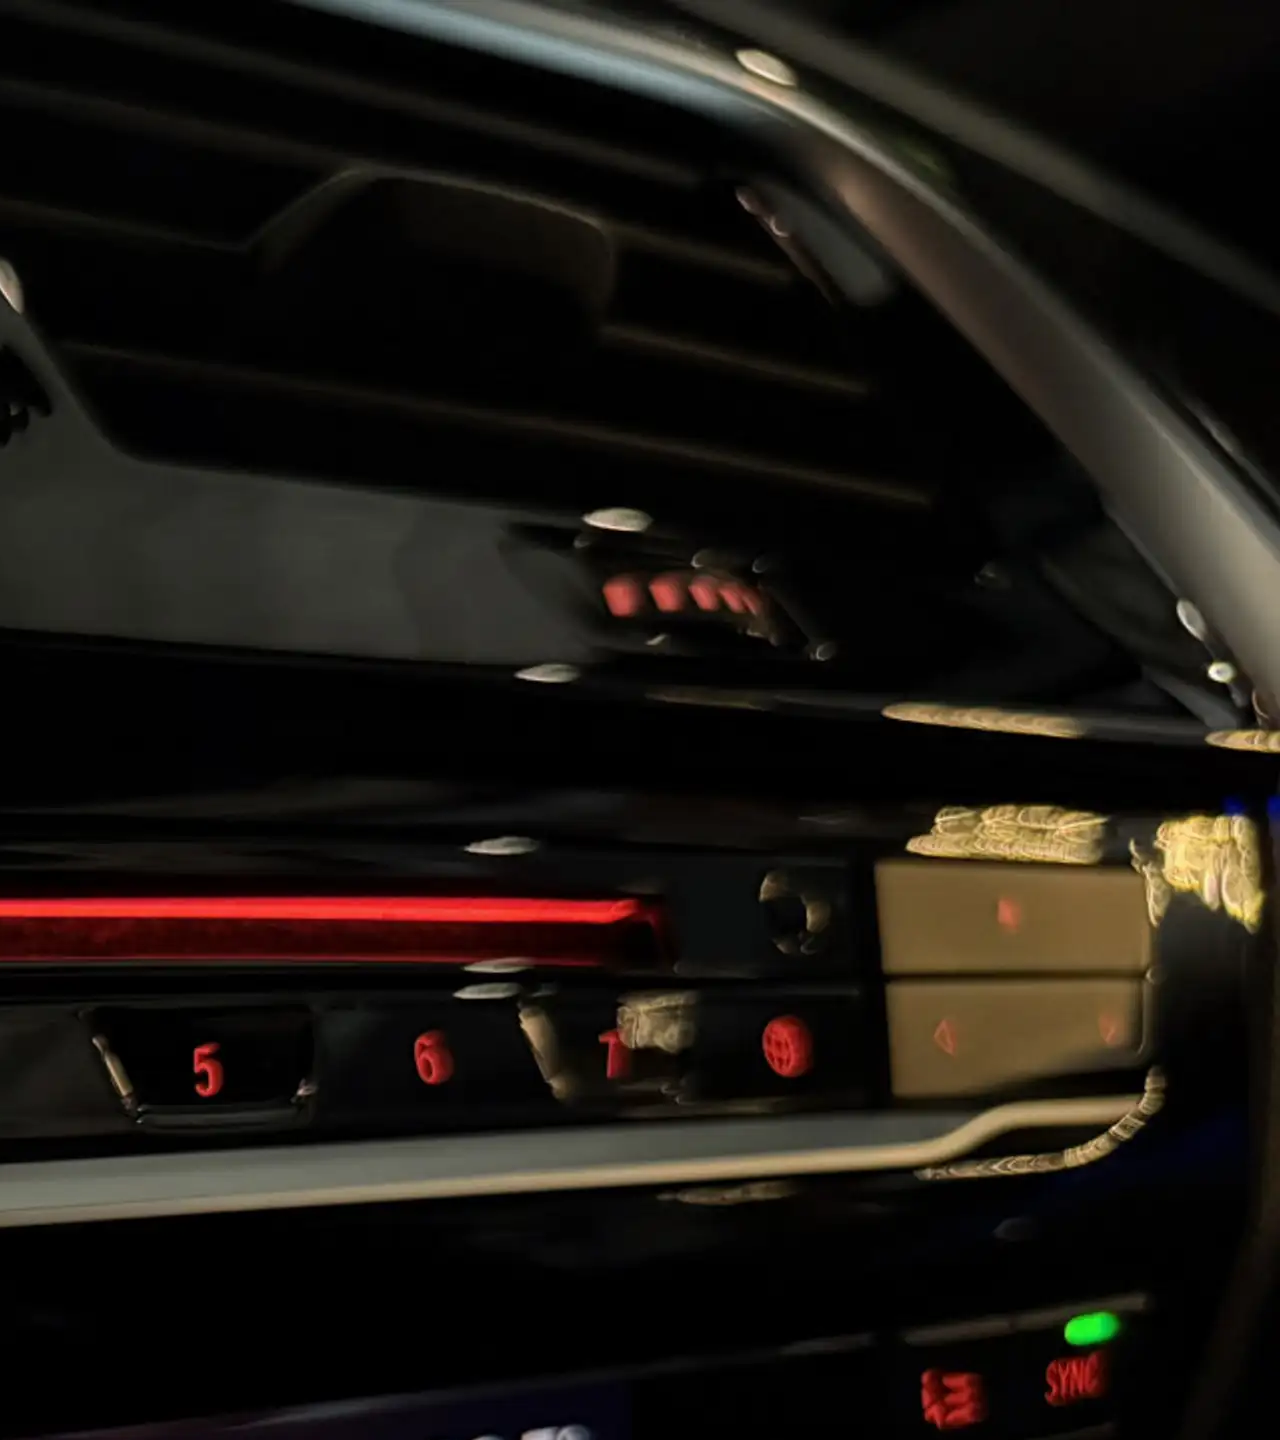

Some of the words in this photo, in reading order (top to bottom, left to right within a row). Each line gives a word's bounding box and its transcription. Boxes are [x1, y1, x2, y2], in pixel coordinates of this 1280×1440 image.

[191, 1041, 225, 1098] 5
[413, 1030, 455, 1086] 6
[1043, 1351, 1110, 1407] SYNC
